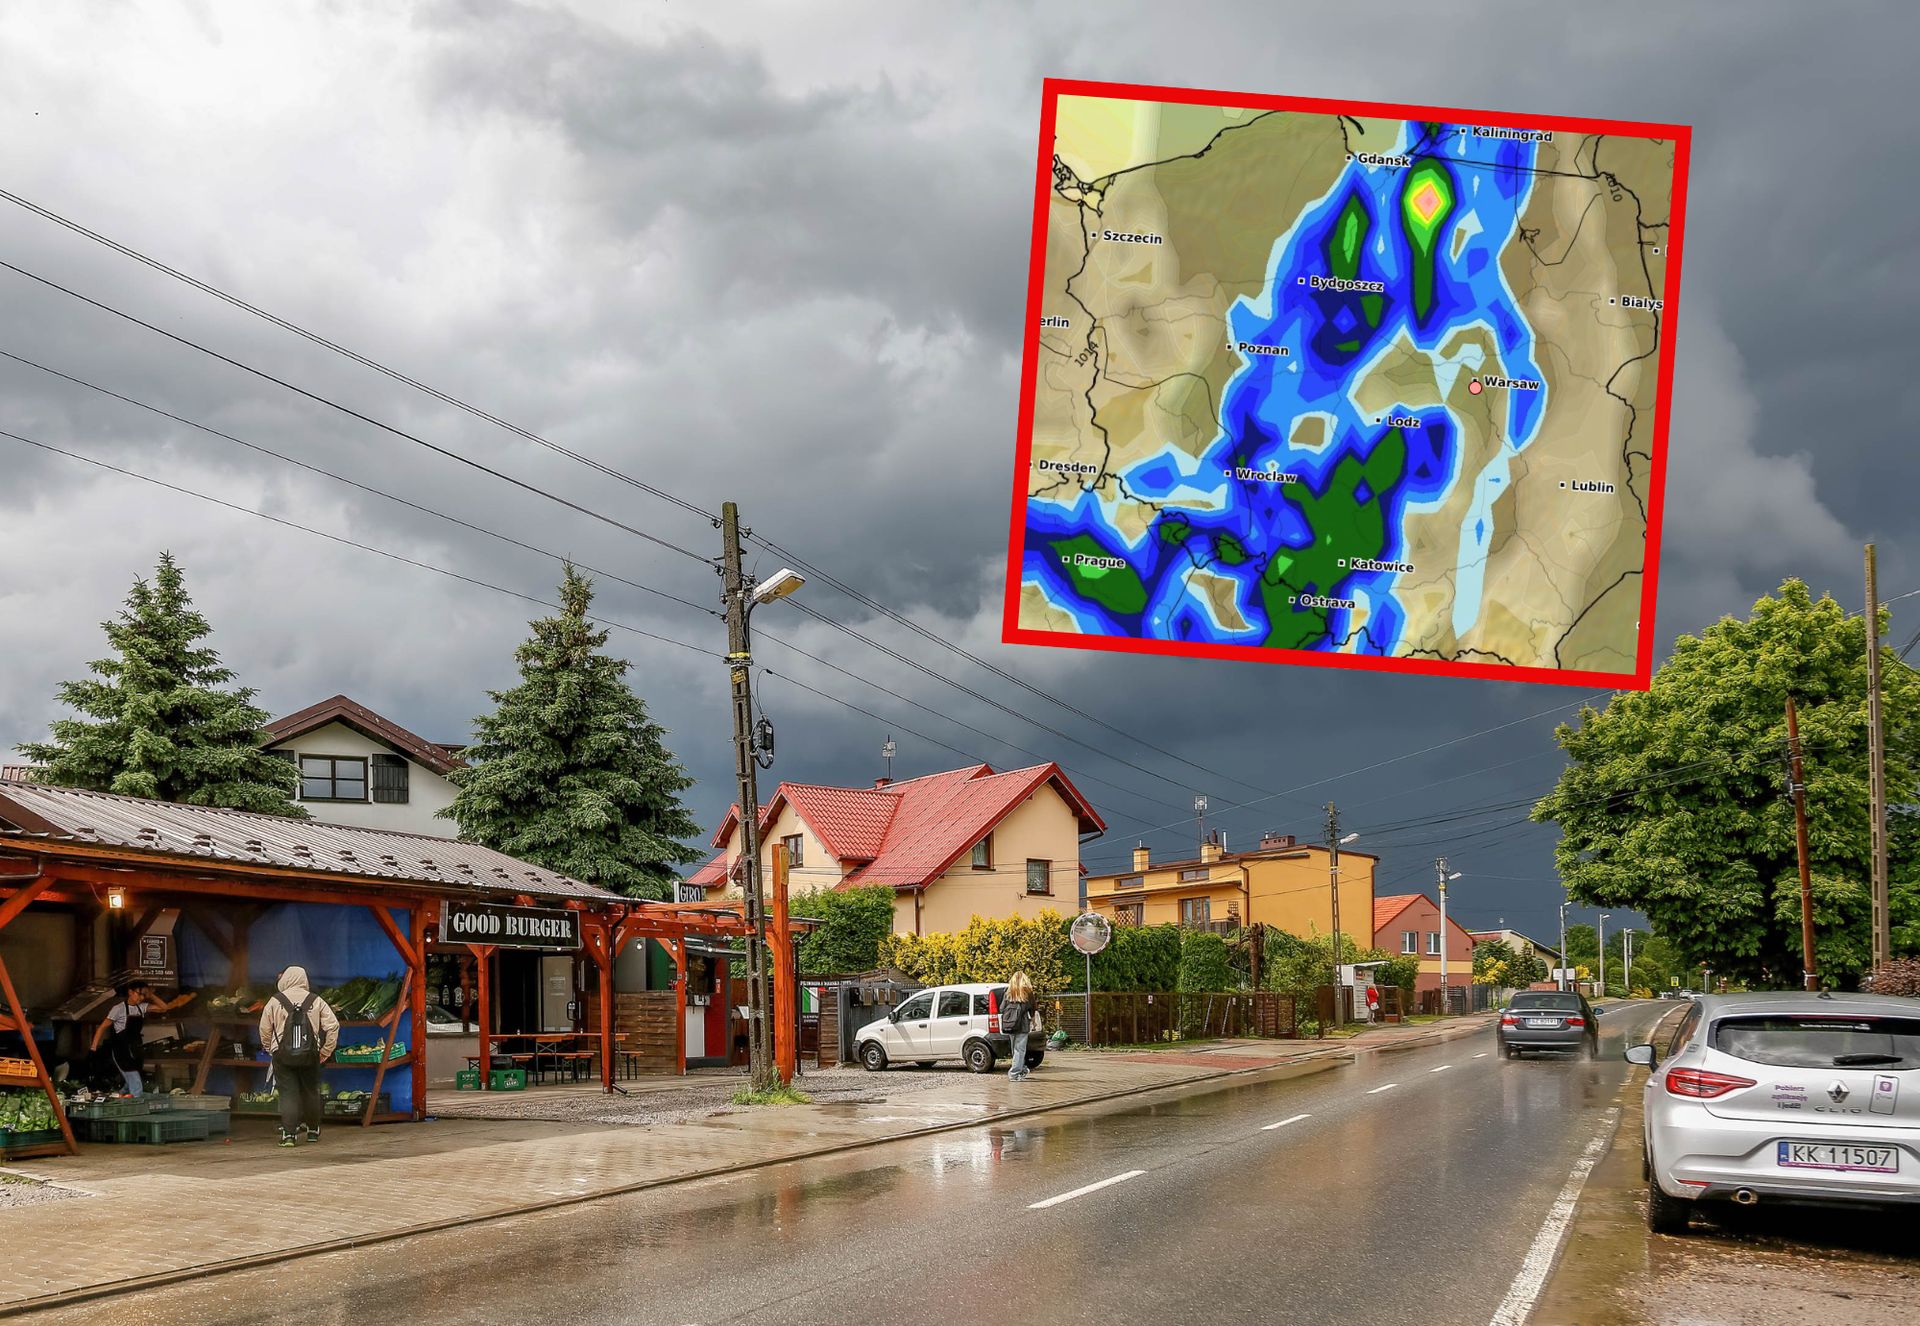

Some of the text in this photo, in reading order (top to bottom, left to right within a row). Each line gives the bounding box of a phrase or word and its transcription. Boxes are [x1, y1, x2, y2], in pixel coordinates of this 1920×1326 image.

[680, 886, 700, 902] GIRO
[453, 912, 572, 938] GOOD BURGER
[1815, 1106, 1862, 1114] CLIO
[1794, 1145, 1819, 1164] KK
[1829, 1147, 1892, 1167] 11507
